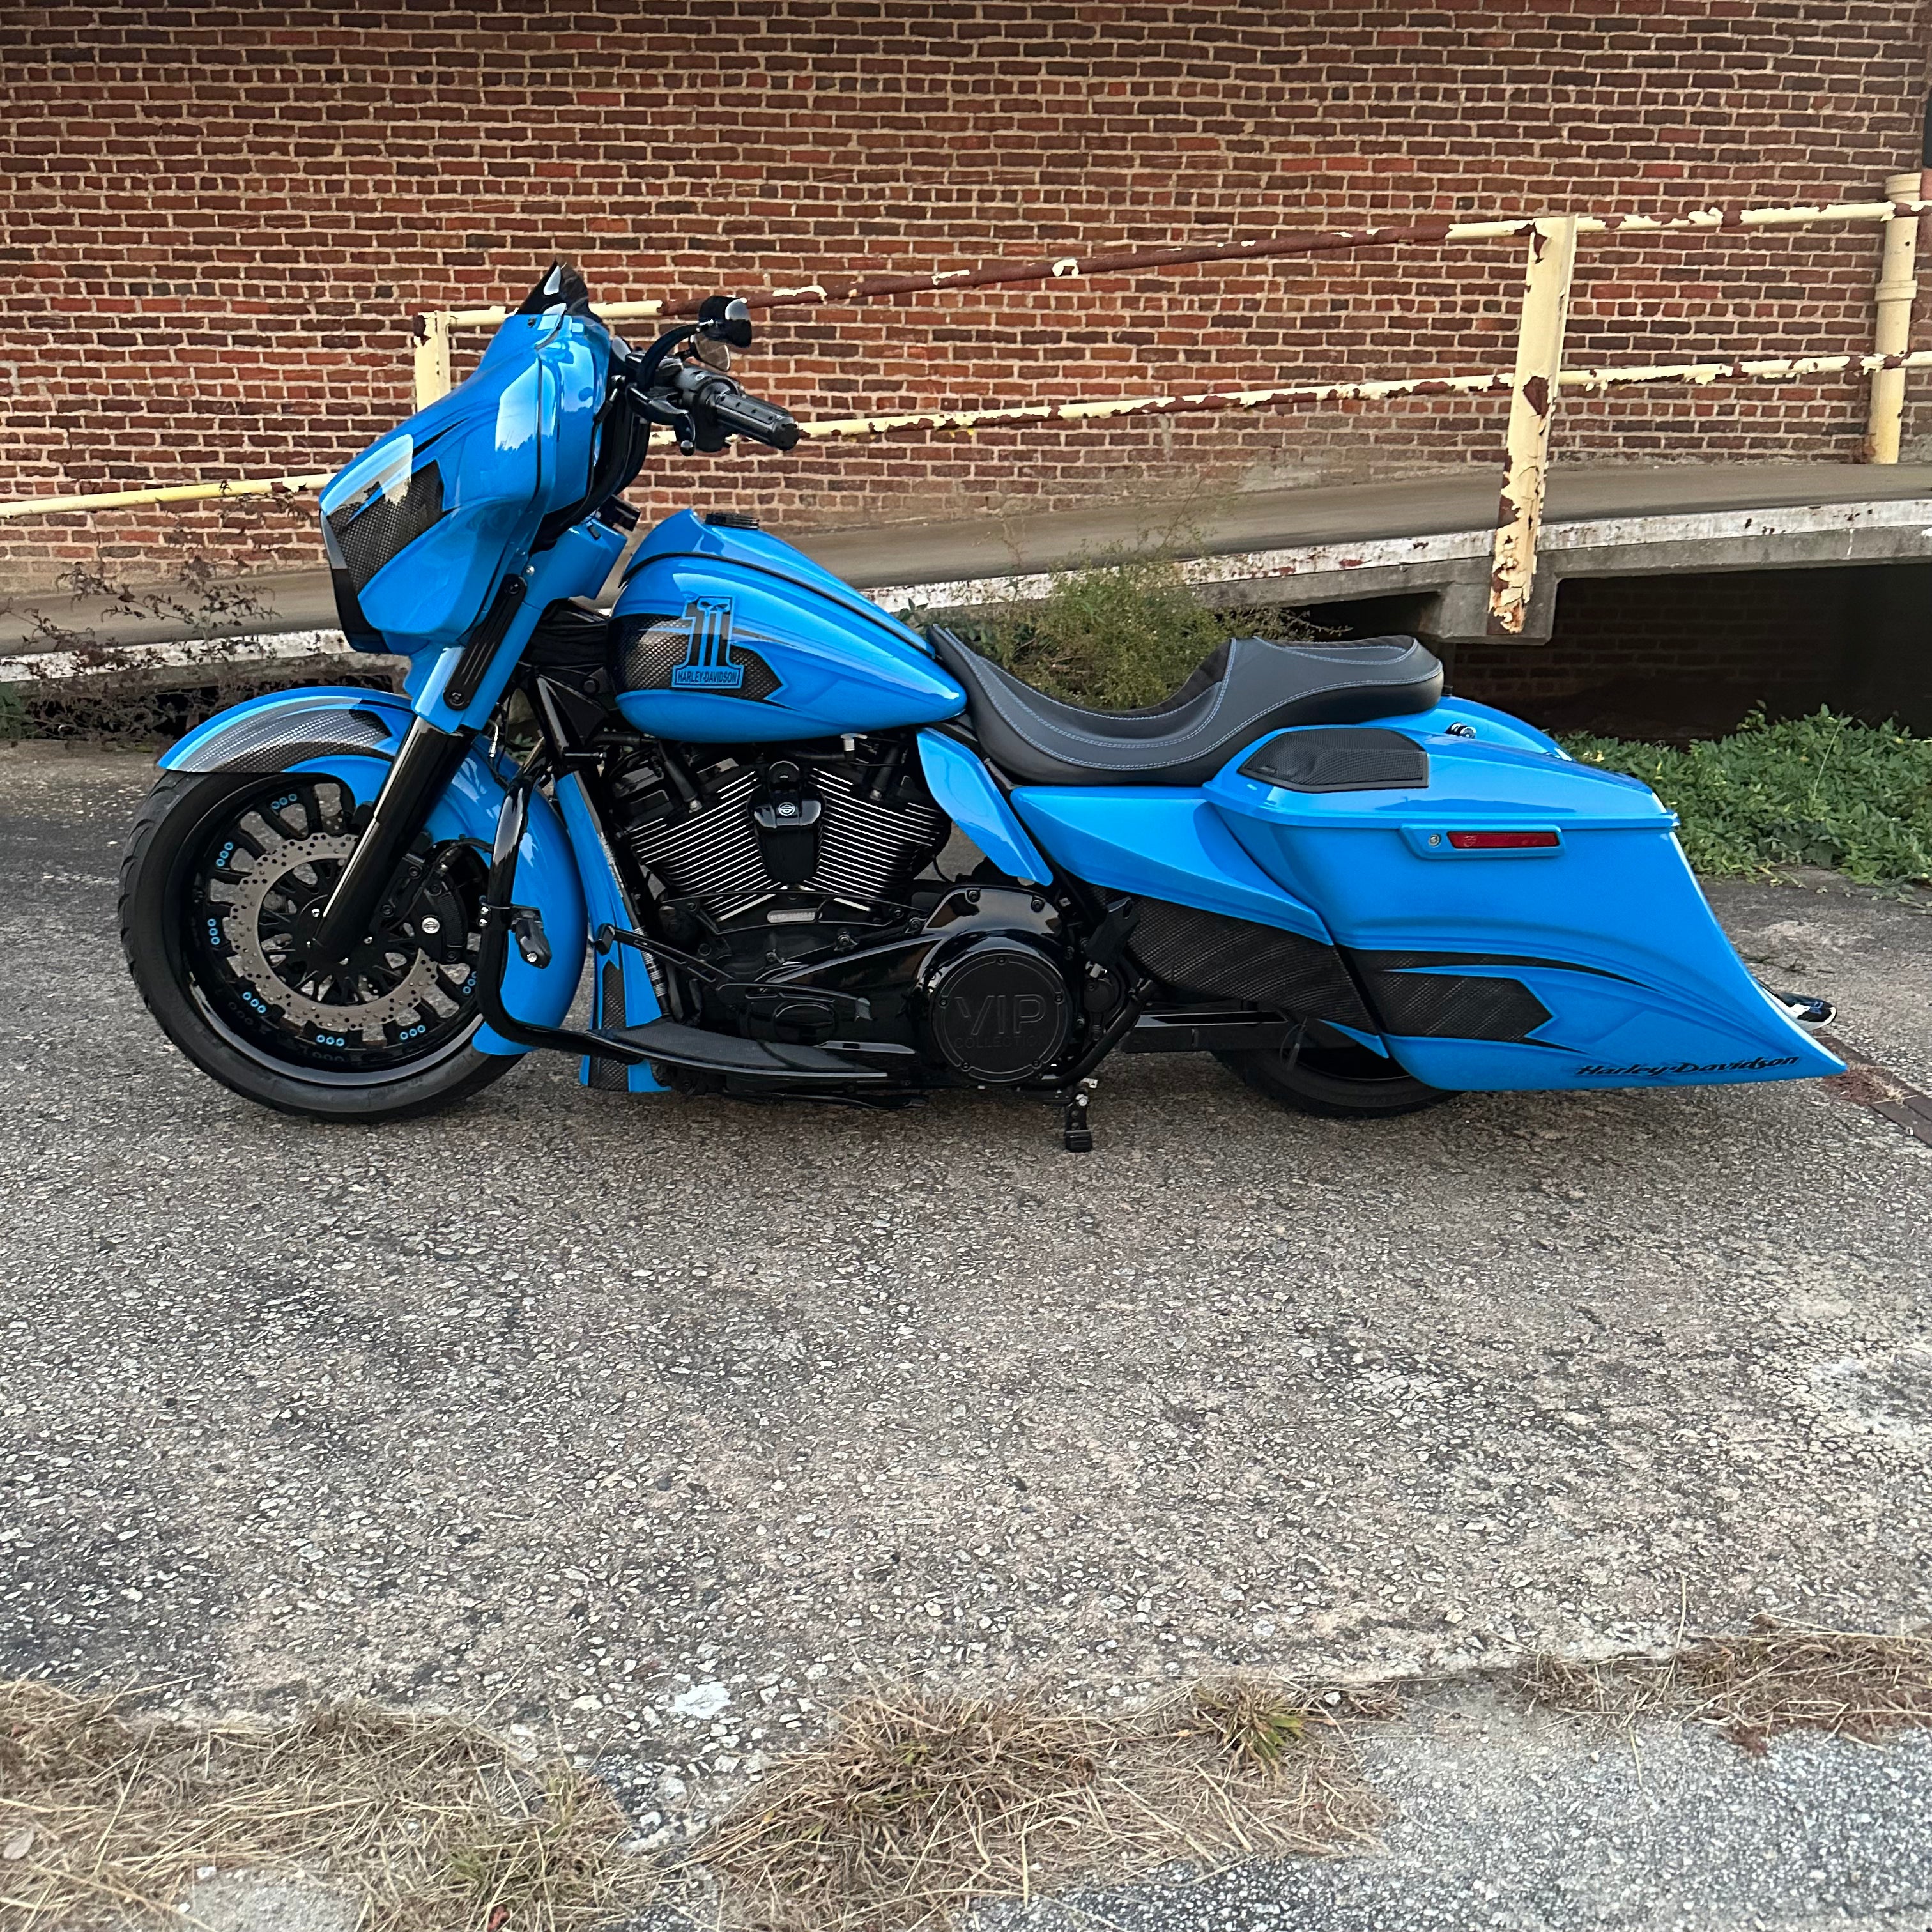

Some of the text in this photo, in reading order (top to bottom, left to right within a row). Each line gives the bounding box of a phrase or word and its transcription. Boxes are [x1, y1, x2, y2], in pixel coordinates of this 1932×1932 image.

[678, 671, 737, 683] HARLEY-DAVIDSON
[954, 994, 1046, 1035] VIP
[1576, 1056, 1800, 1077] Harley-Davidson
